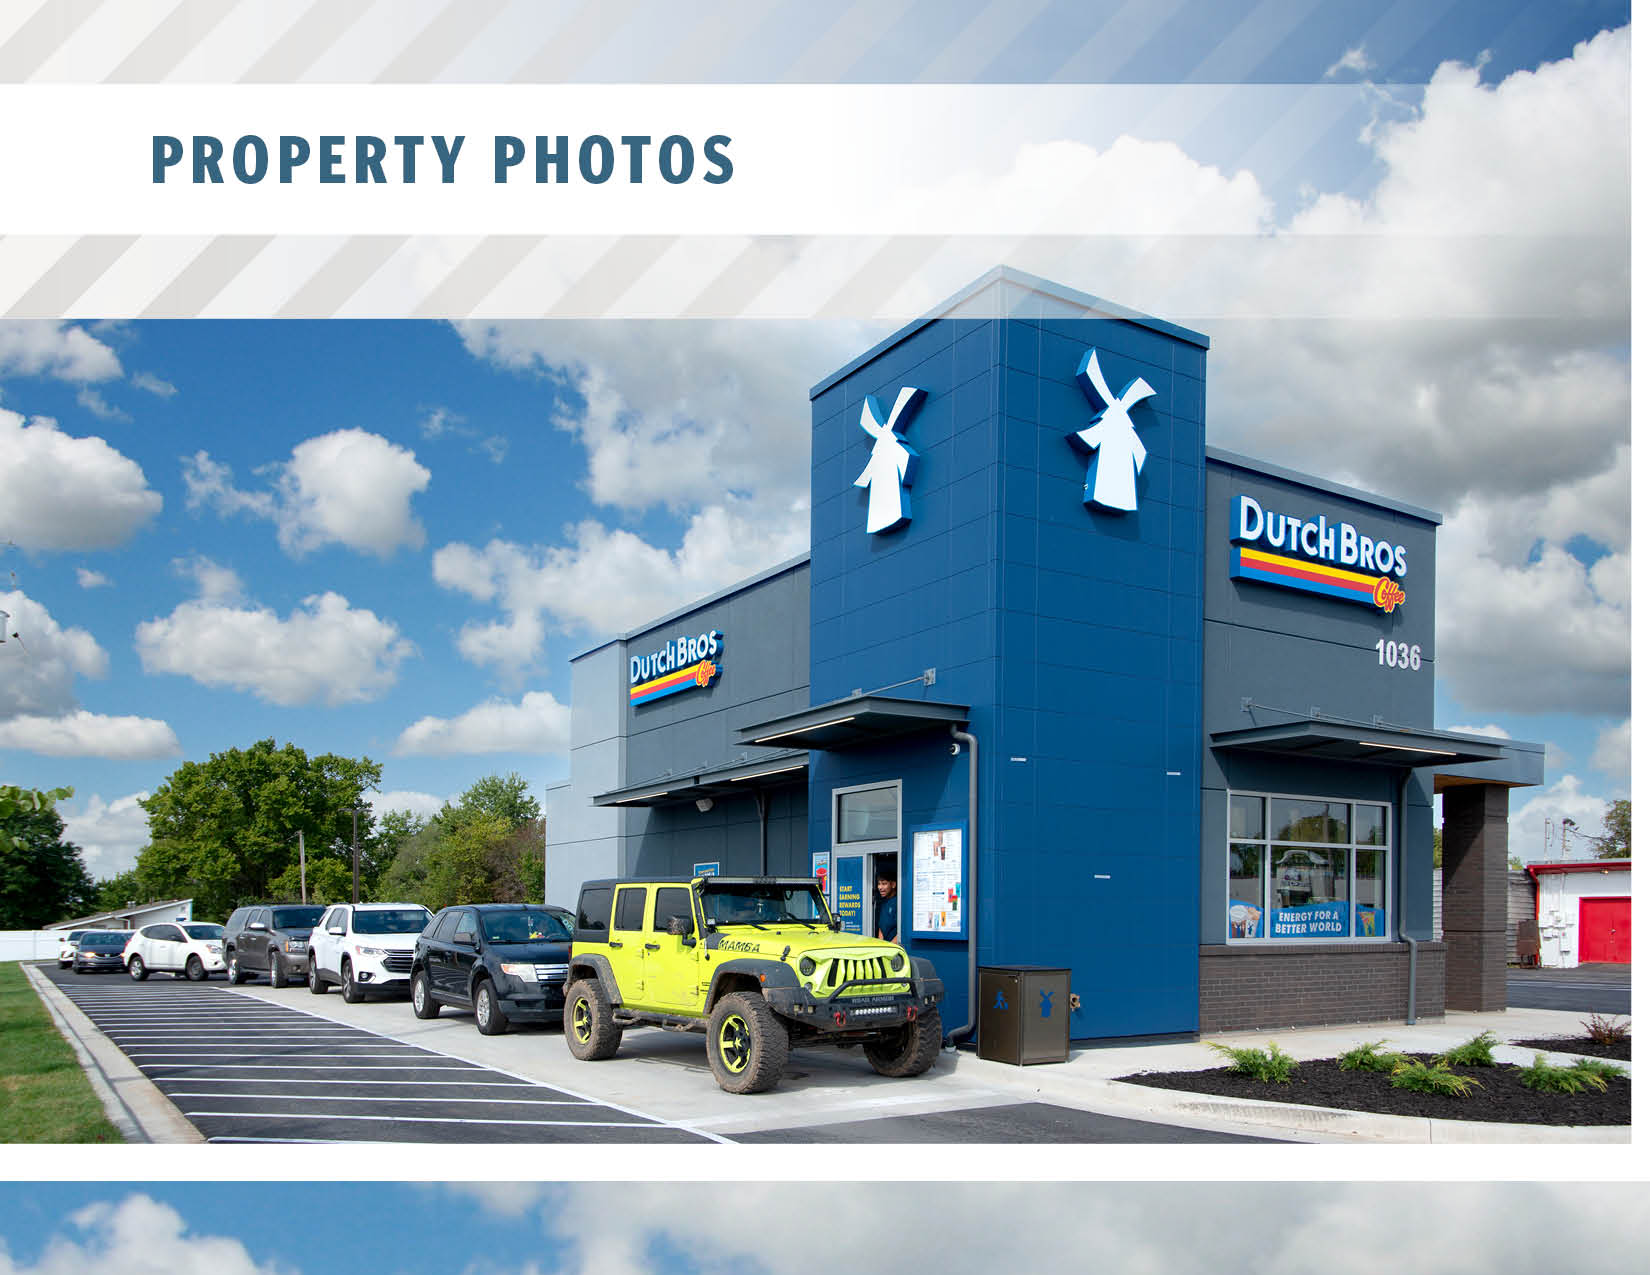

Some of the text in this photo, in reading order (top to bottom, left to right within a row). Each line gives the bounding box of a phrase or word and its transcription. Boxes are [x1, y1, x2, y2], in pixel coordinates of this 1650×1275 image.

[1240, 495, 1408, 577] DUTCH BROS
[1373, 576, 1406, 613] Coffee
[630, 630, 718, 684] DUTCH BROS
[1375, 639, 1421, 671] 1036
[1275, 922, 1342, 934] BETTER WORLD
[1278, 910, 1339, 922] ENERGY FOR A
